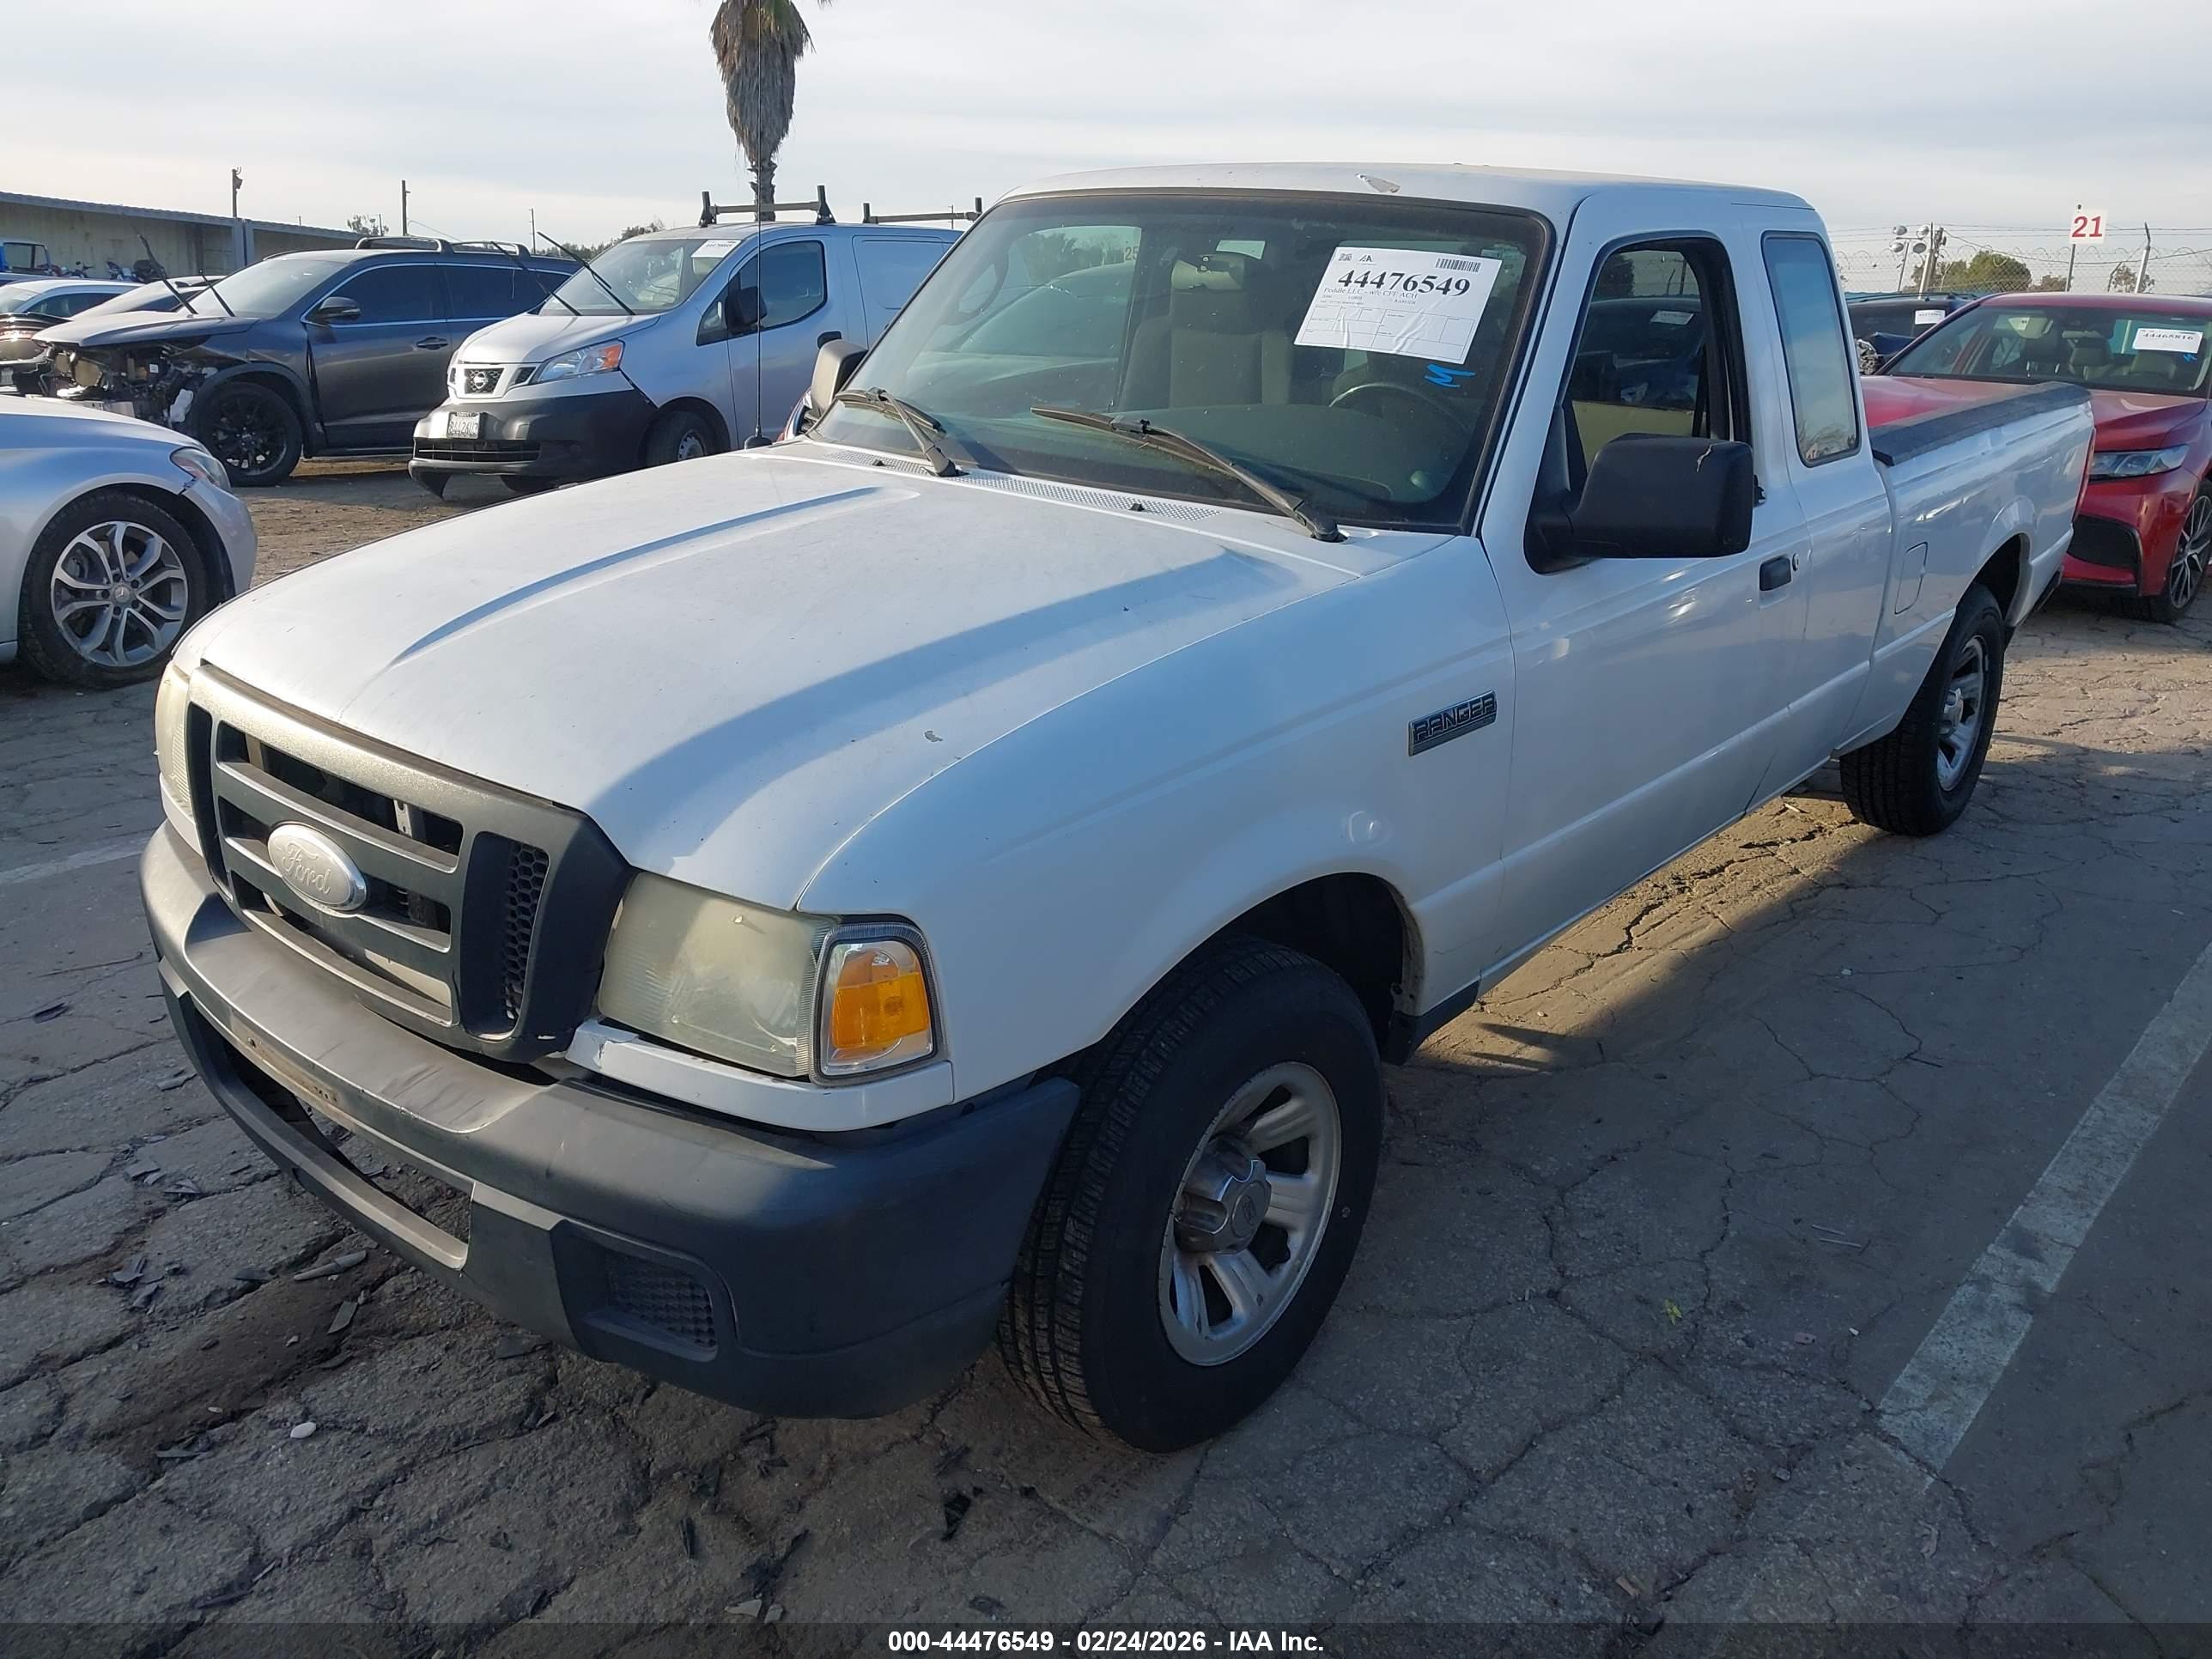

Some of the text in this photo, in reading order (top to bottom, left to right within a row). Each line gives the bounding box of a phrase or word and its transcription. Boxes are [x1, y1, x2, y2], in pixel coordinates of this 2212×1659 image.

[2071, 216, 2103, 238] 21
[1338, 270, 1471, 297] 44476549
[1414, 696, 1494, 742] RANGER
[276, 841, 332, 895] Ford
